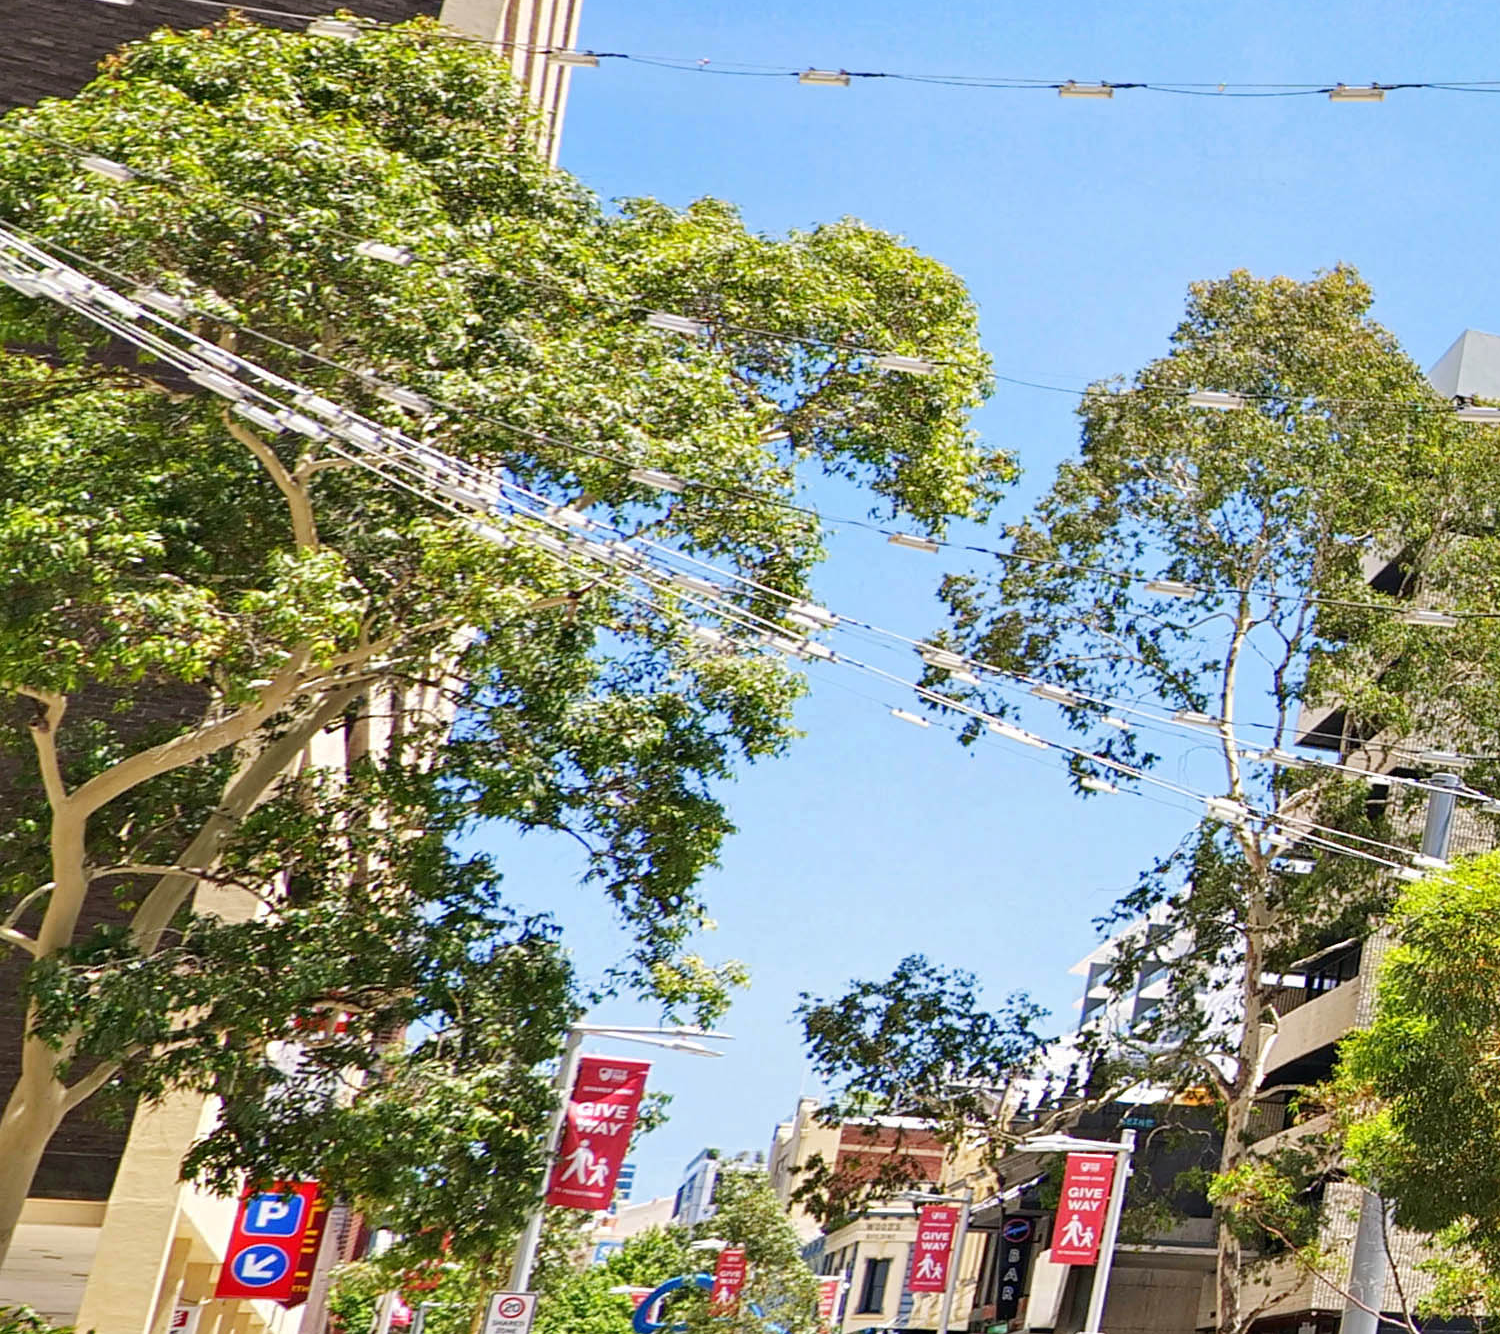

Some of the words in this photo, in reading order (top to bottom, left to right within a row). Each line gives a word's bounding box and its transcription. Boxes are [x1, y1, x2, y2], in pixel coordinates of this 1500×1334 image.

[576, 1102, 629, 1120] GIVE
[575, 1117, 624, 1136] WAY
[1068, 1187, 1104, 1199] GIVE
[1067, 1200, 1101, 1211] WAY
[255, 1201, 290, 1228] P
[921, 1232, 950, 1241] GIVE
[921, 1242, 947, 1251] WAY
[719, 1270, 742, 1278] GIVE
[1002, 1249, 1021, 1301] BAR
[503, 1302, 521, 1313] 20
